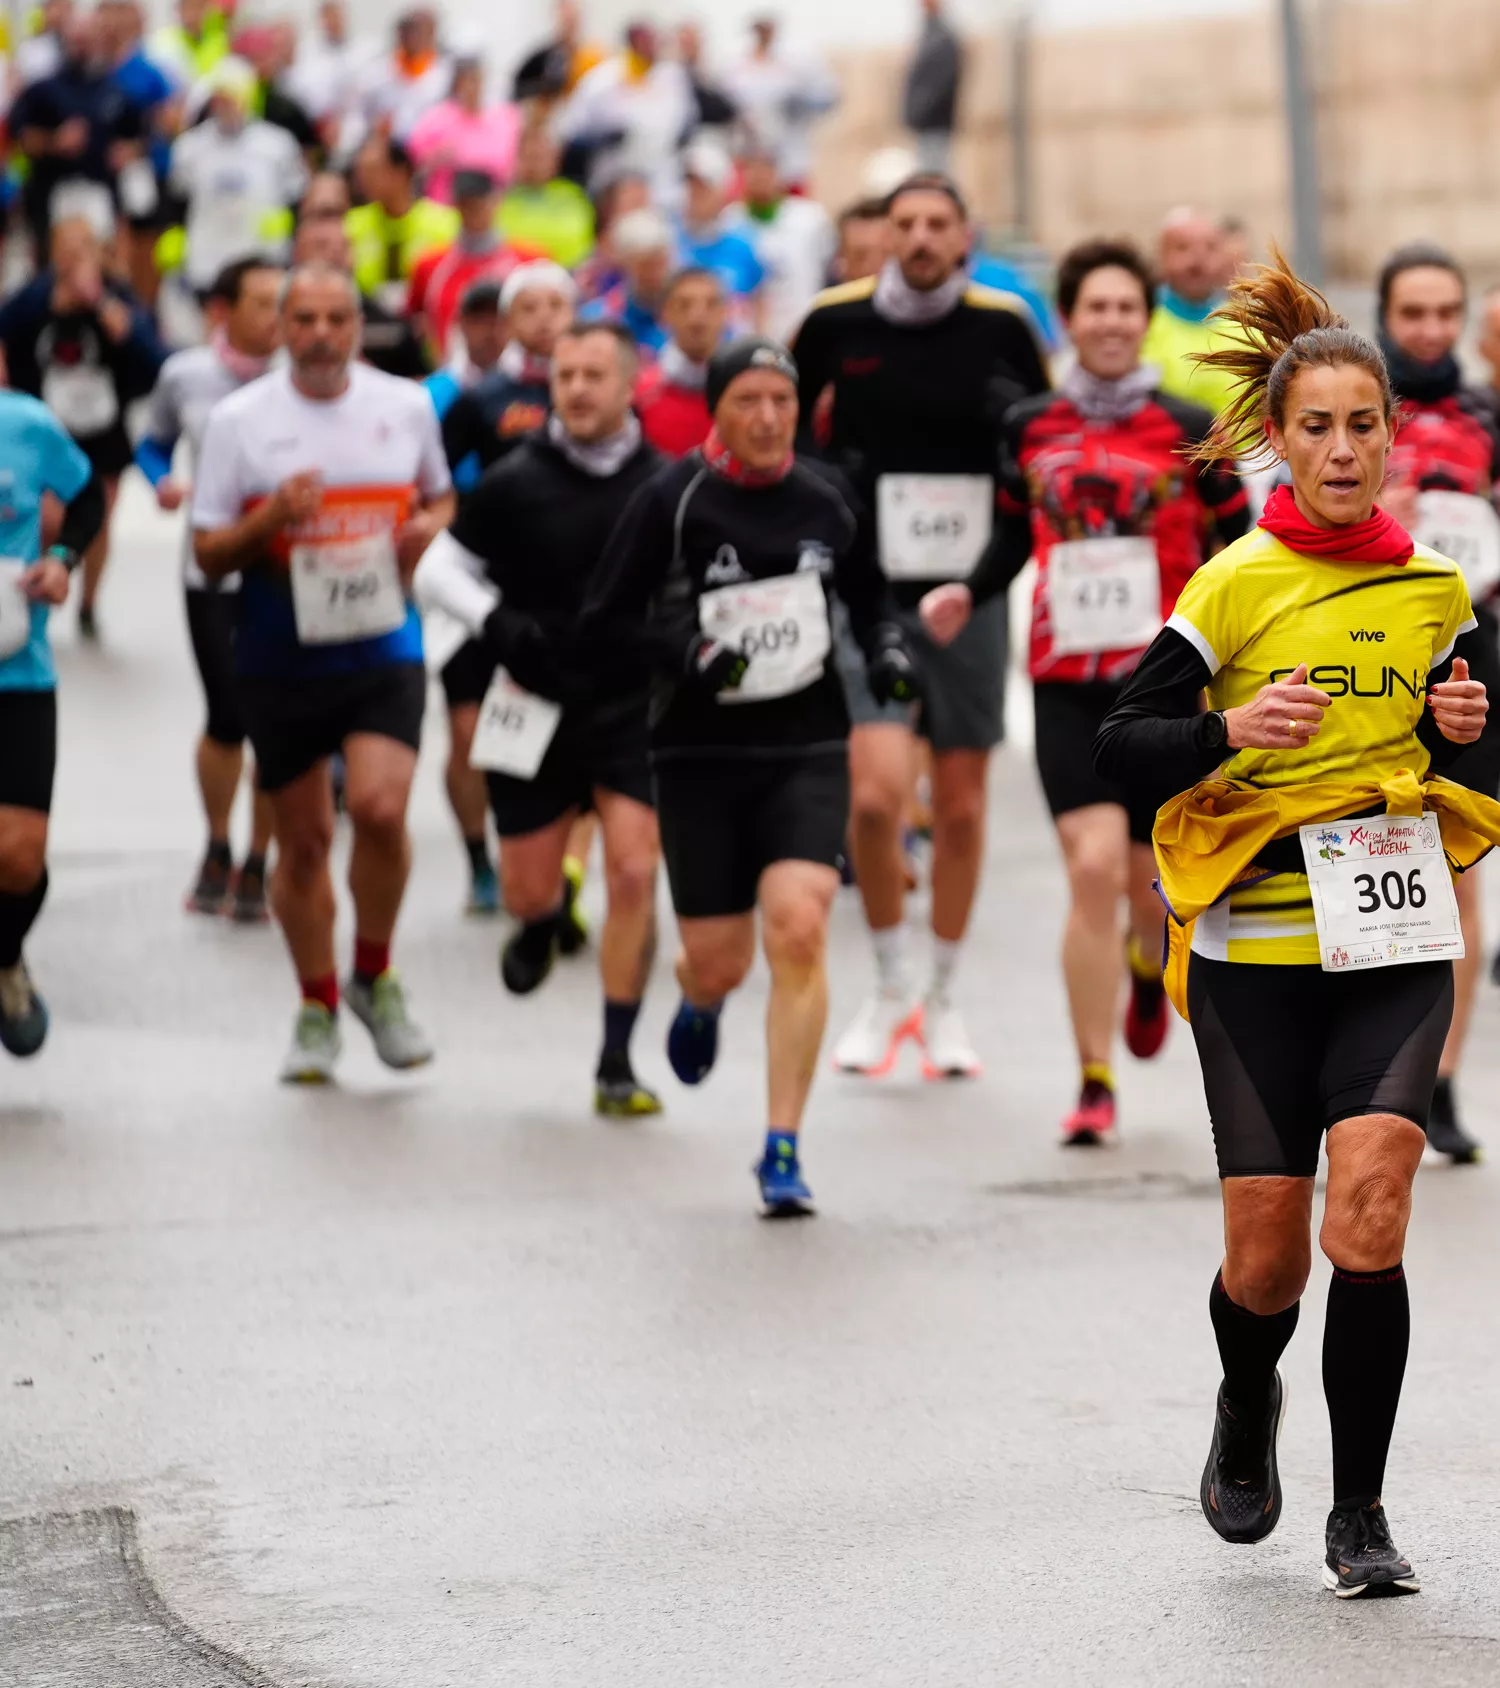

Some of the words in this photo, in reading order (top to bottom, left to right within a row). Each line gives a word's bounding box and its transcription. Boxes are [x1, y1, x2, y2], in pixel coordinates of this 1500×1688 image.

[741, 618, 799, 656] 609
[1349, 628, 1385, 642] vive
[1368, 840, 1412, 856] LUCENA
[1354, 869, 1426, 913] 306
